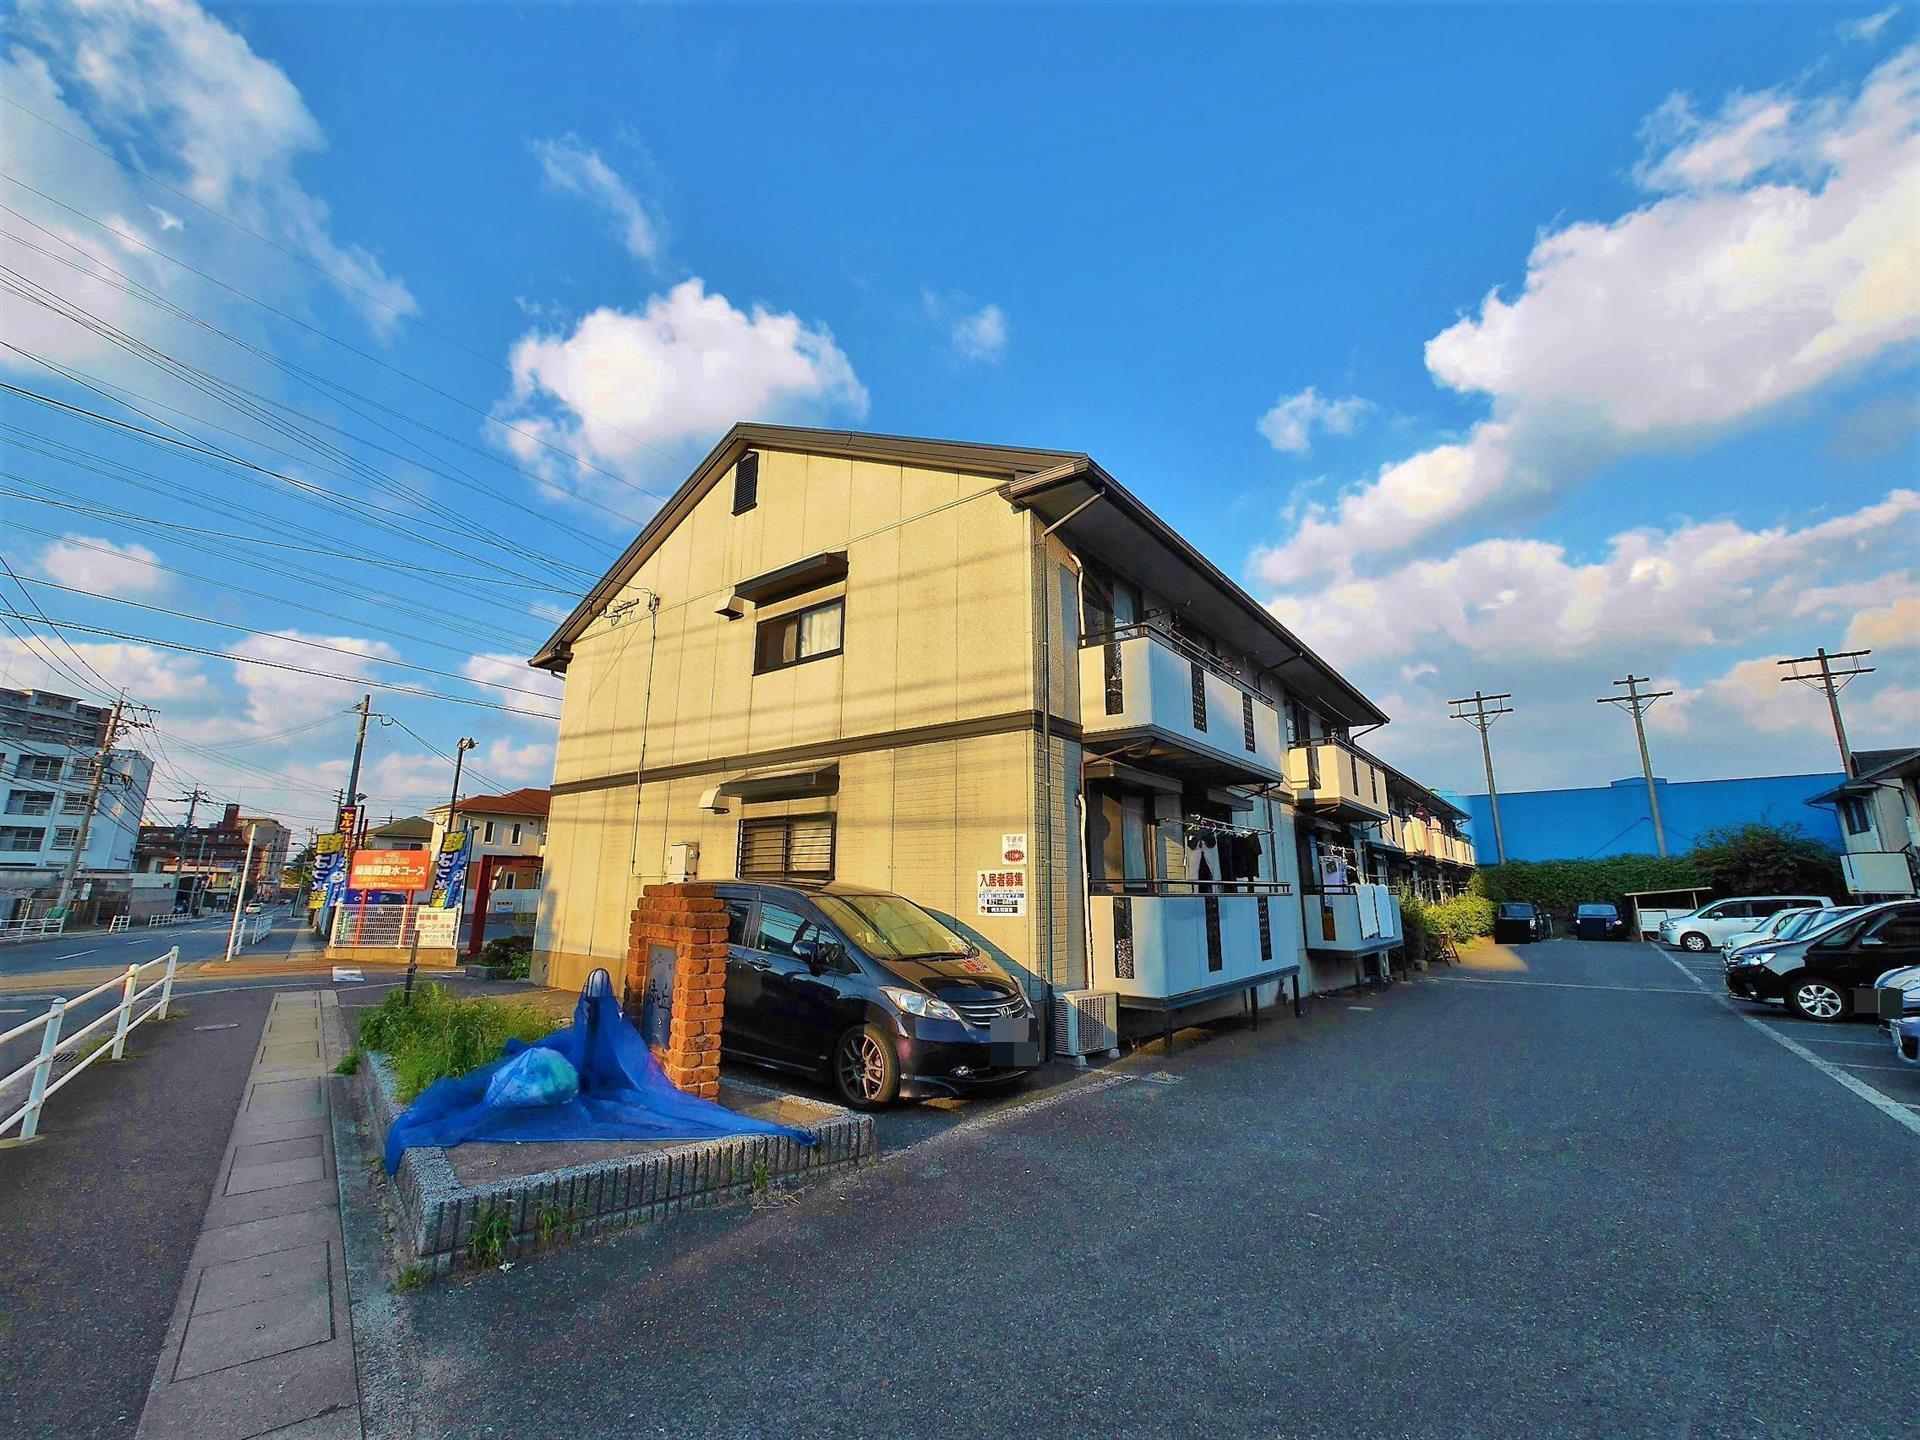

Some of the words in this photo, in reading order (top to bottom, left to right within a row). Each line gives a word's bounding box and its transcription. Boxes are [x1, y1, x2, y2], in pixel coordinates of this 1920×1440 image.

[979, 872, 1023, 887] 入居者募集
